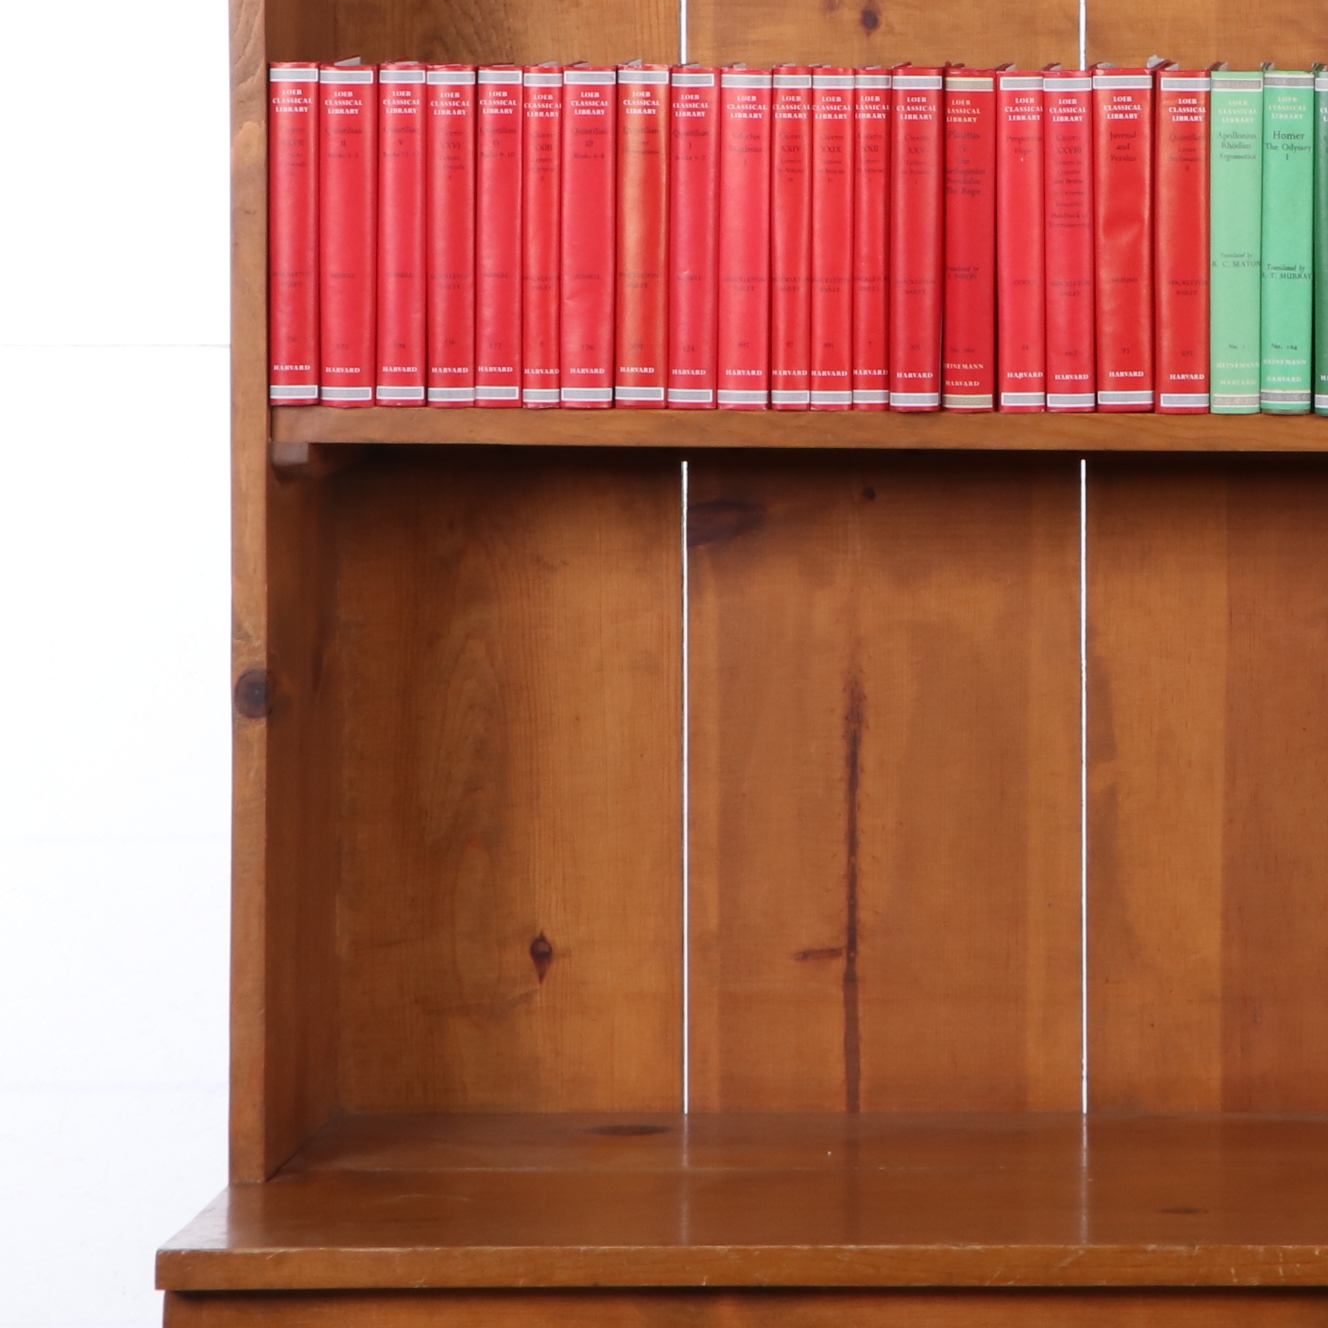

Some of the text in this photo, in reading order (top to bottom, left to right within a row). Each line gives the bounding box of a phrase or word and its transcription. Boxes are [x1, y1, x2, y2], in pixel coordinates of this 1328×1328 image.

[272, 97, 312, 105] CLASSICAL
[324, 99, 363, 107] CLASSICAL
[737, 95, 757, 103] LOEB
[907, 96, 927, 104] LOEB
[1015, 97, 1035, 105] LOEB
[430, 100, 470, 108] CLASSICAL
[570, 100, 609, 108] CLASSICAL
[1103, 104, 1142, 112] CLASSICAL
[1168, 106, 1206, 114] CLASSICAL
[900, 113, 934, 121] LIBRARY
[1008, 114, 1041, 122] LIBRARY
[1107, 113, 1138, 121] LIBRARY
[1171, 115, 1203, 123] LIBRARY
[1272, 130, 1305, 140] Homer
[1265, 143, 1279, 151] The
[325, 366, 361, 374] HARVARD
[1108, 370, 1145, 378] HARVARD
